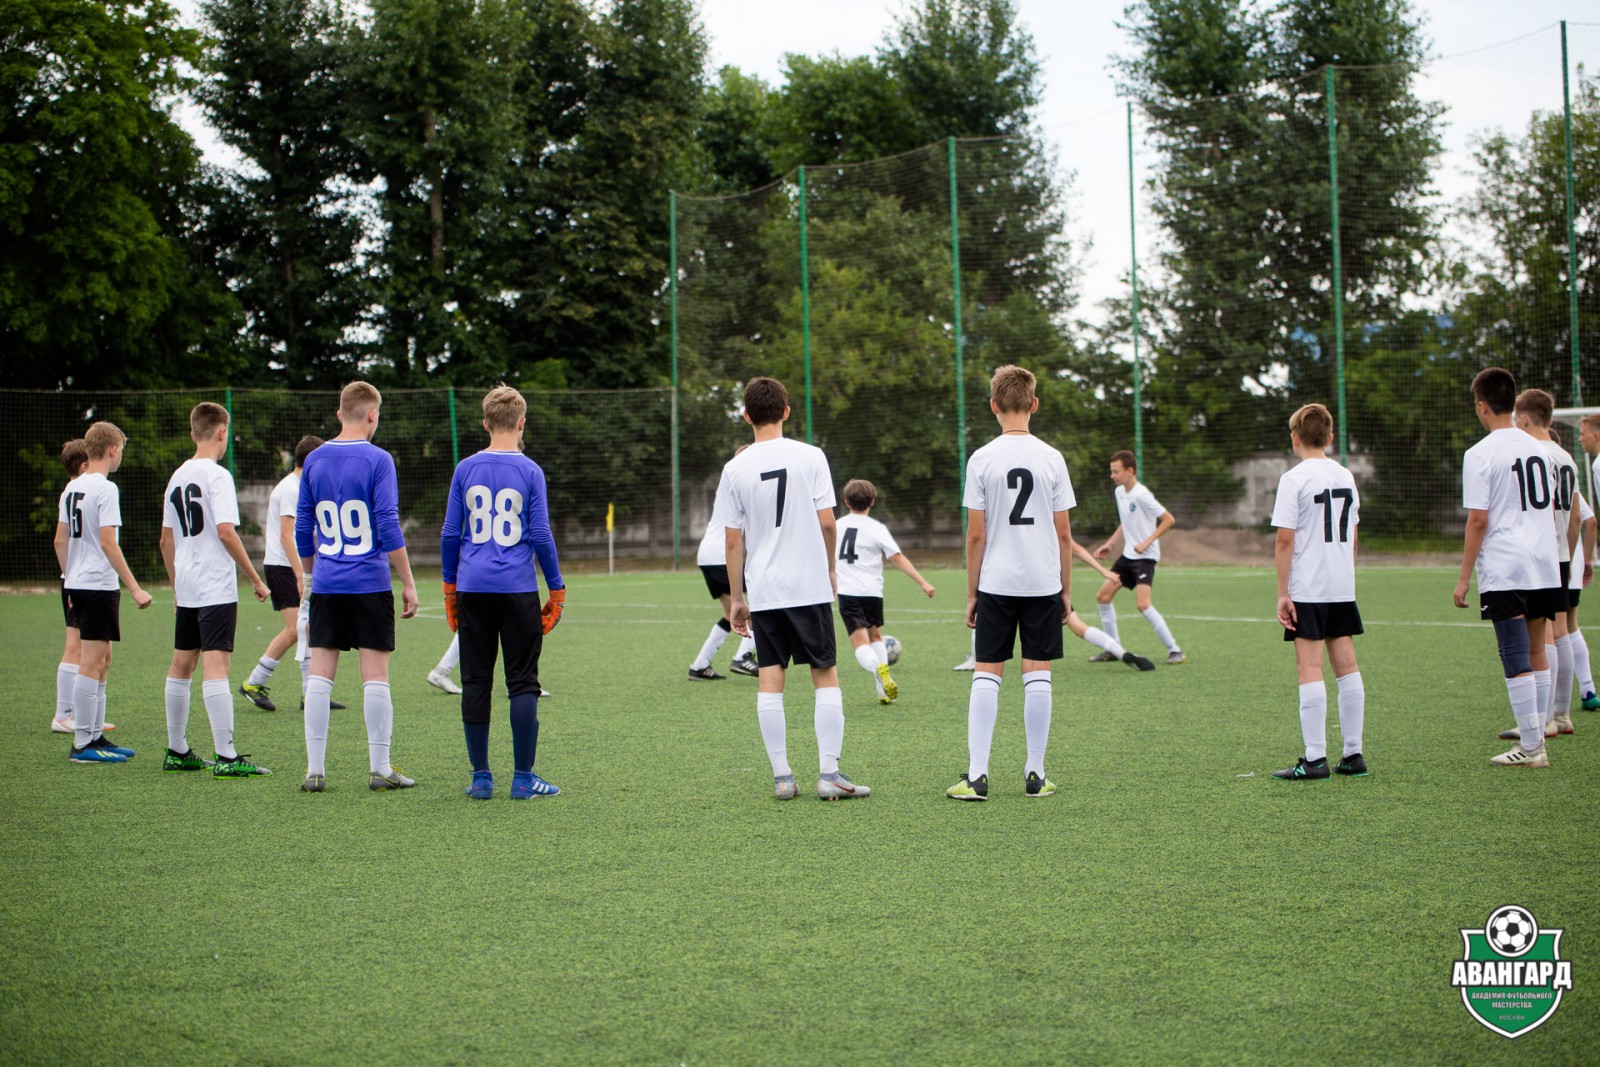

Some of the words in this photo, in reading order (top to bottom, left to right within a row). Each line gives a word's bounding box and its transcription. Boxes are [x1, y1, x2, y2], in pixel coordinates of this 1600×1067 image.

[169, 482, 205, 538] 16
[760, 467, 788, 528] 7
[1006, 467, 1035, 525] 2
[1511, 455, 1551, 512] 10
[65, 491, 86, 538] 15
[315, 499, 373, 556] 99
[465, 484, 523, 547] 88
[1313, 488, 1354, 543] 17
[838, 527, 859, 564] 4
